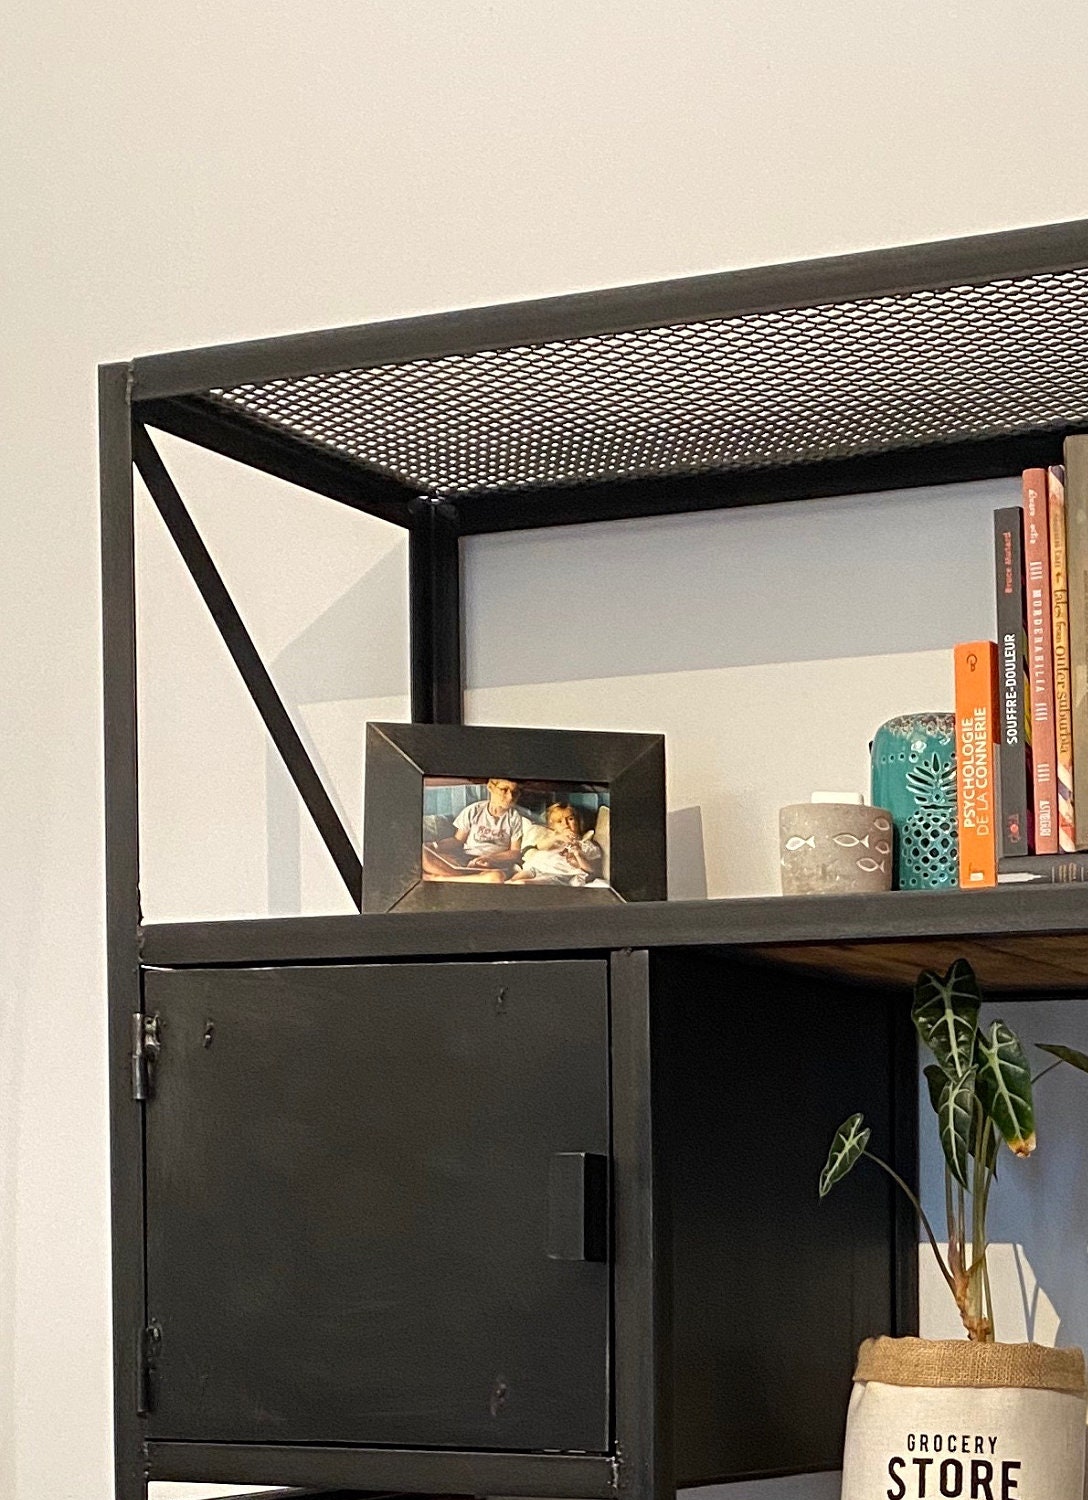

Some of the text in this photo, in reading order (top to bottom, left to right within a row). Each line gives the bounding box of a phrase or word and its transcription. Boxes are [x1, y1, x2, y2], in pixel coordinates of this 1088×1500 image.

[1003, 568, 1013, 594] Bruce
[1005, 634, 1018, 744] SOUFFRE-DOULEUR
[1032, 589, 1046, 692] MURDERABILIA
[962, 718, 976, 828] PSYCHOLOGIE
[974, 707, 989, 836] DE LA CONNERIE
[907, 1433, 997, 1454] GROCERY
